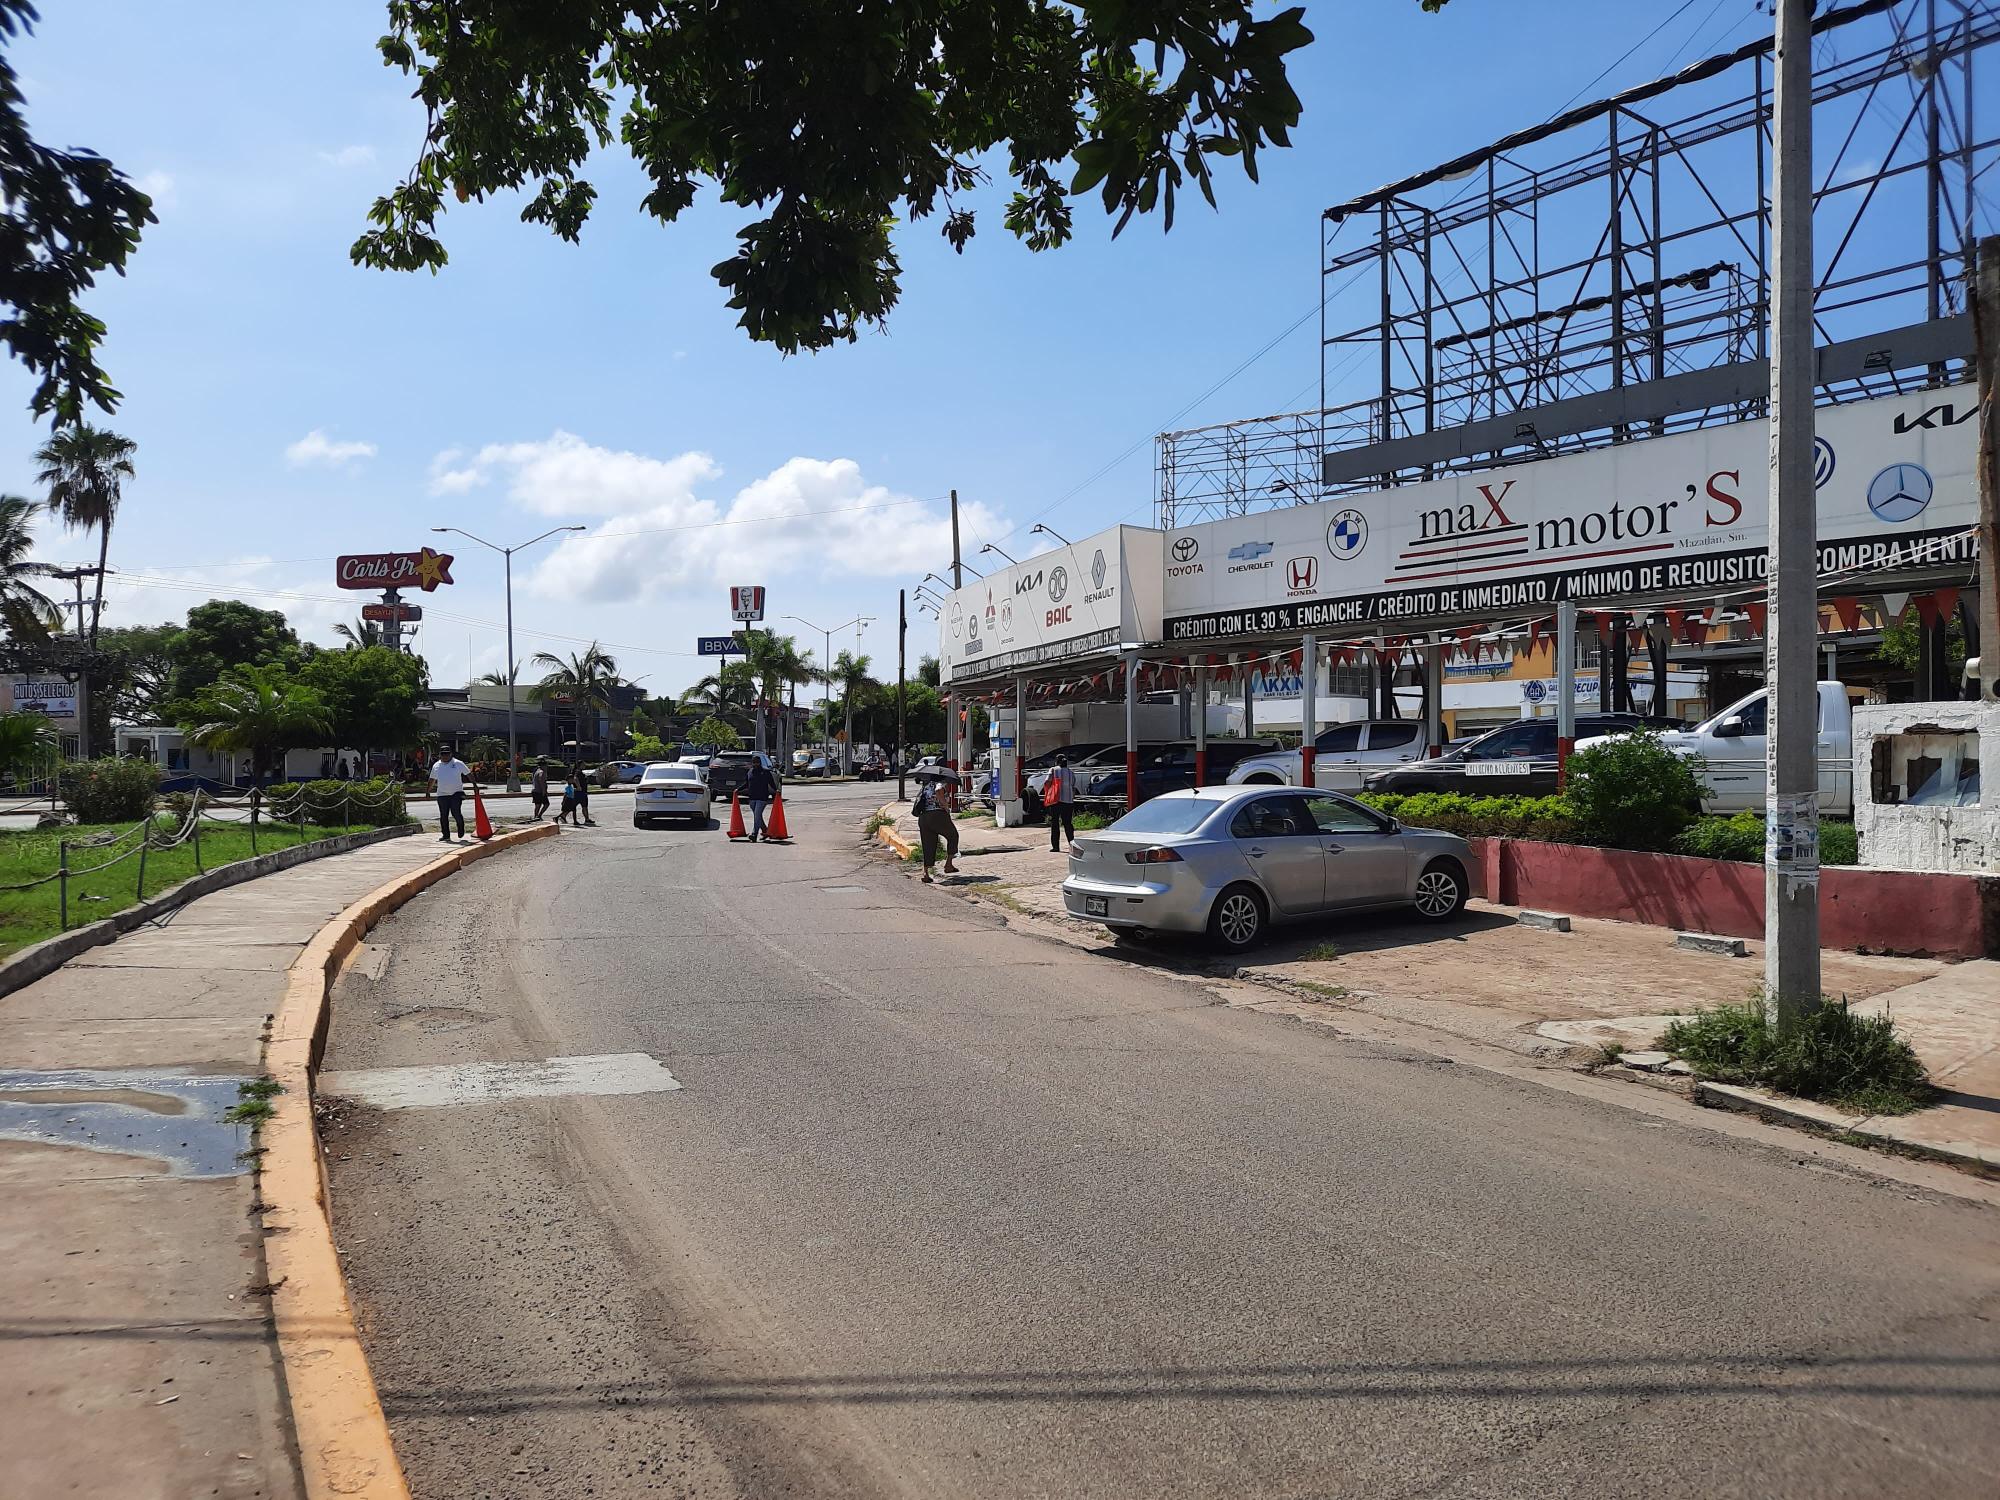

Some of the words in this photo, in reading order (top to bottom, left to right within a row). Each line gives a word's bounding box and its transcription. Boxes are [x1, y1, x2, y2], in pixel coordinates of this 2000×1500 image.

[1419, 480, 1518, 539] maX
[1332, 512, 1362, 527] BMW
[342, 556, 390, 580] Carl's
[1167, 563, 1204, 578] TOYOTA
[1228, 561, 1274, 574] CHEVROLET
[1084, 586, 1115, 604] RENAULT
[1287, 588, 1318, 597] HONDA
[1173, 617, 1216, 638] CRÉDITO
[1220, 615, 1241, 634] CON
[1245, 613, 1259, 631] EL
[1260, 611, 1276, 630] 30
[1279, 609, 1290, 628] %
[1297, 600, 1363, 626] ENGANCHE
[1378, 592, 1436, 617] CRÉDITO
[1440, 590, 1459, 611] DE
[1462, 580, 1546, 610] INMEDIATO
[1567, 569, 1633, 598] MÍNIMO
[1640, 566, 1663, 590] DE
[1046, 604, 1073, 628] BAIC
[704, 640, 740, 652] BBVA
[14, 684, 37, 699] AUTOS
[40, 683, 75, 698] SELECTOS
